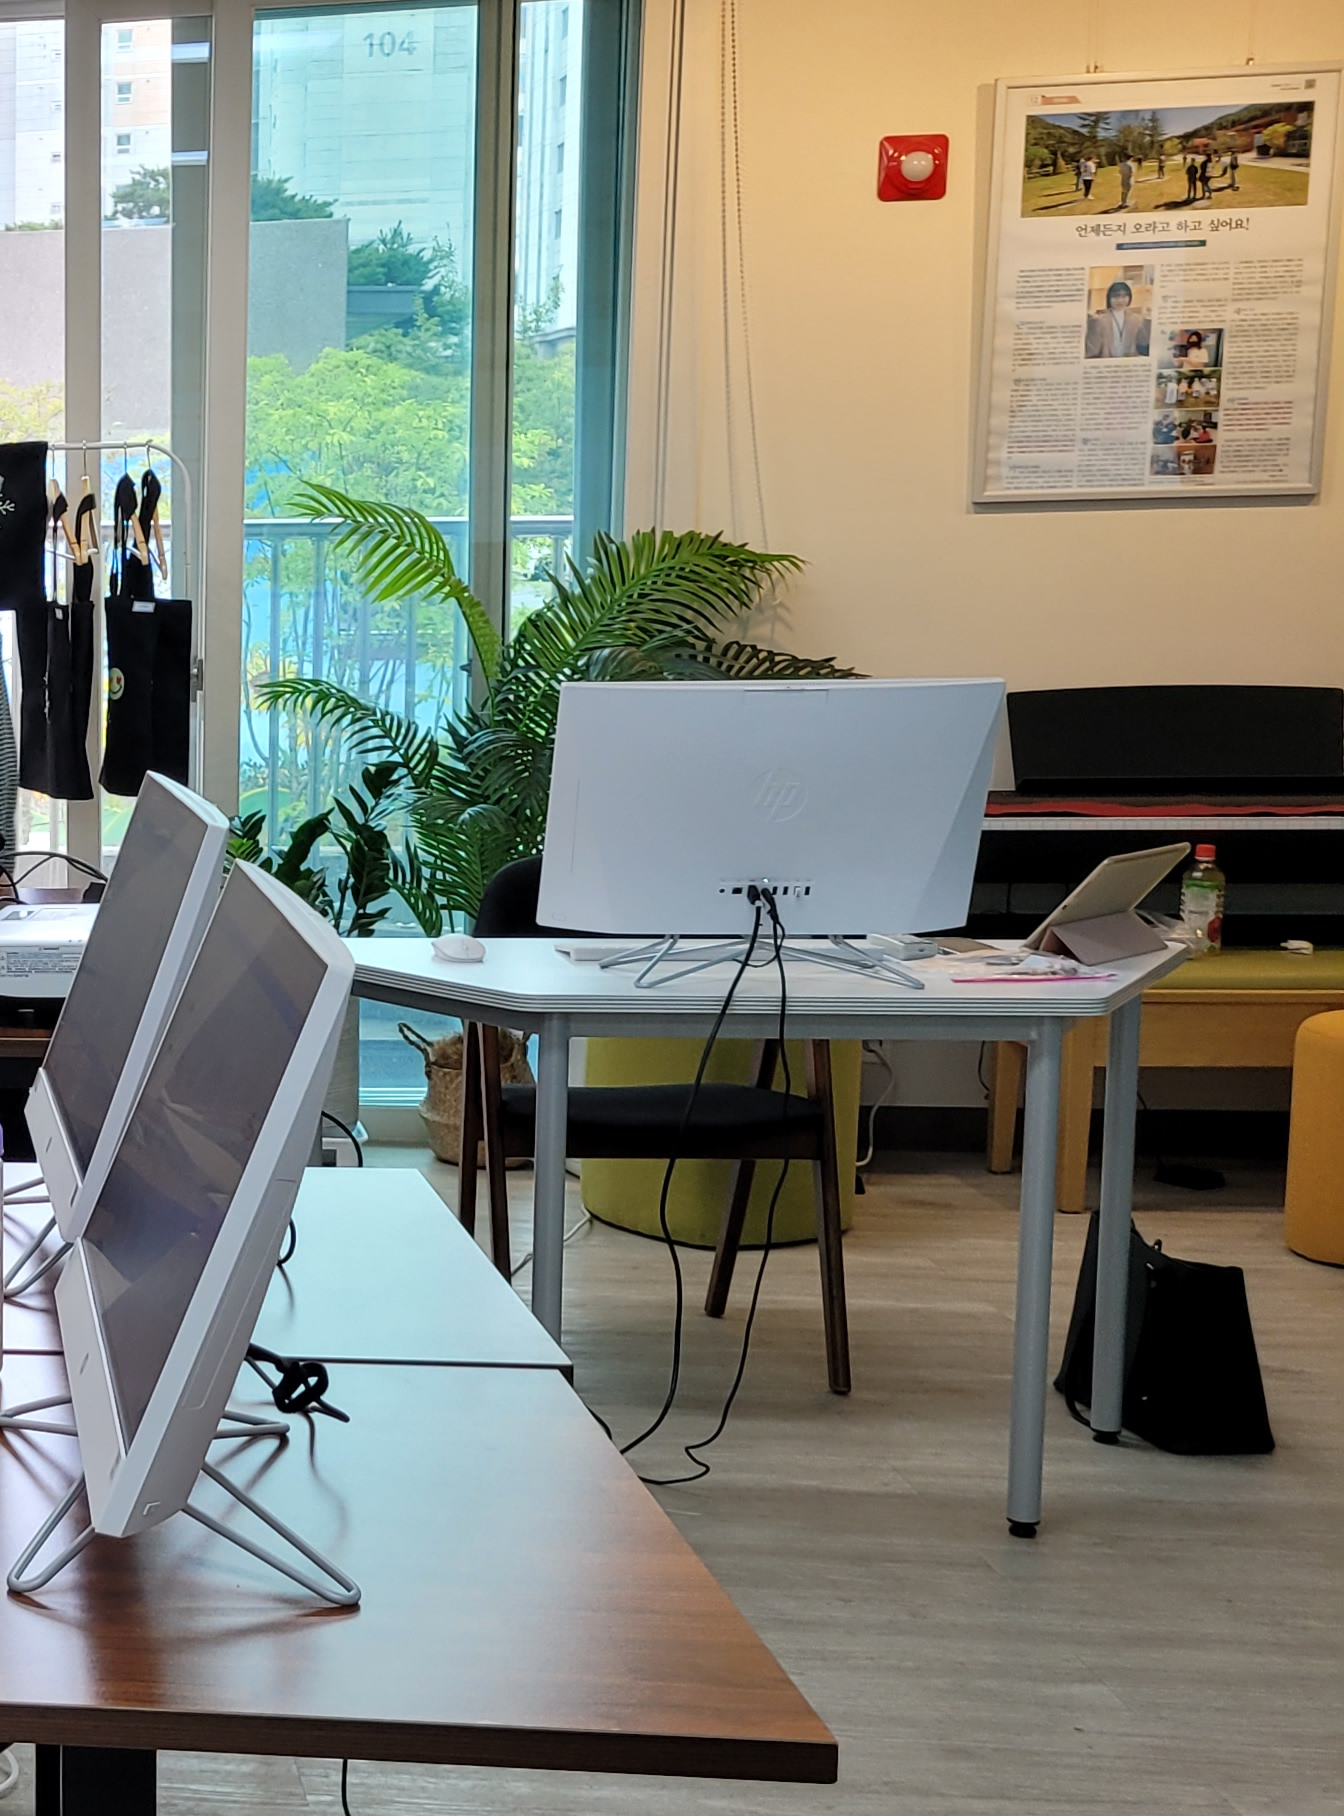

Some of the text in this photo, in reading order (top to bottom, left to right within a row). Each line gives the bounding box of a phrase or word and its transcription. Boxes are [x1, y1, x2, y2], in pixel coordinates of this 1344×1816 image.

[363, 31, 416, 57] 104
[1075, 217, 1250, 238] 언제든지 오라고 하고 싶어요!
